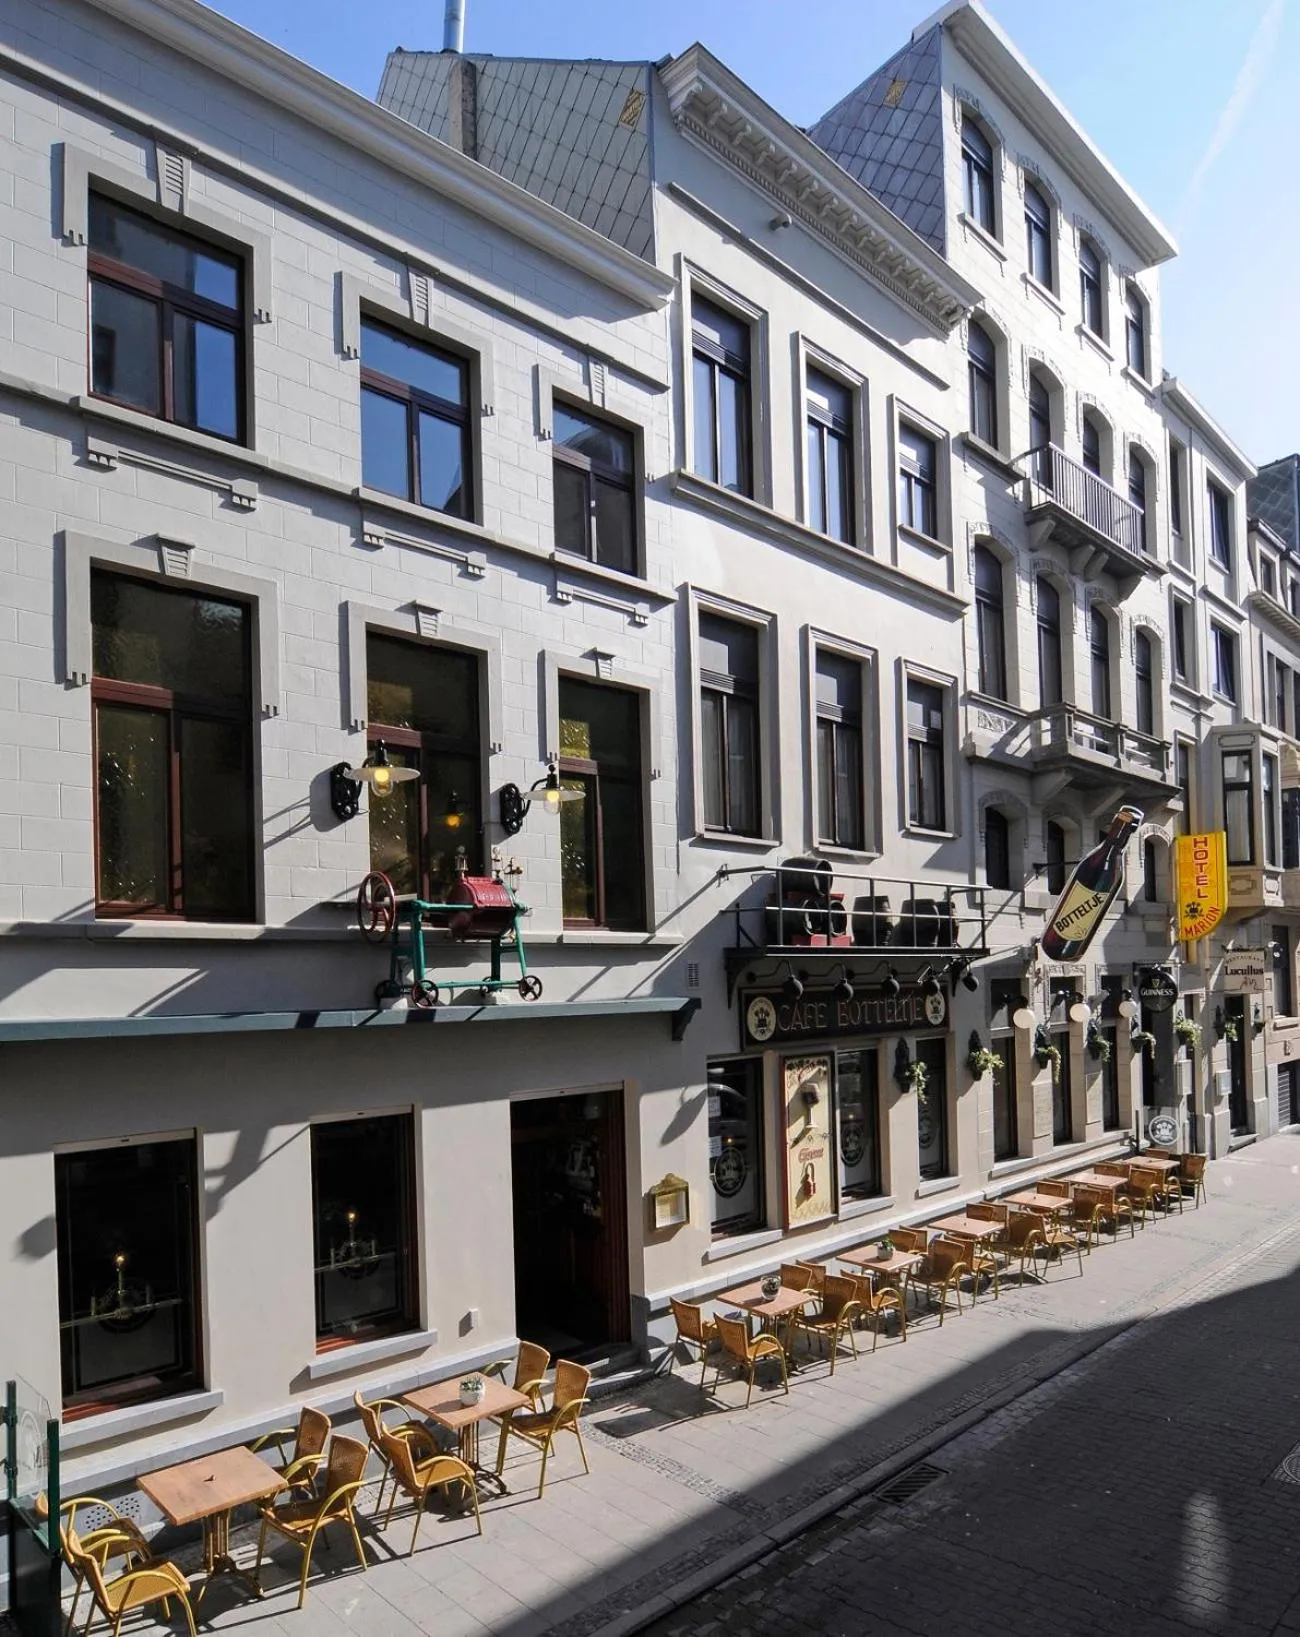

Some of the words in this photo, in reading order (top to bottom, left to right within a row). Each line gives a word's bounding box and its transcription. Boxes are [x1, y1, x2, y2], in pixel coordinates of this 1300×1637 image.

[1193, 836, 1209, 899] HOTEL
[1055, 892, 1104, 932] BOTTELTJE
[1184, 906, 1220, 937] MARION
[1141, 987, 1174, 996] GUINNESS
